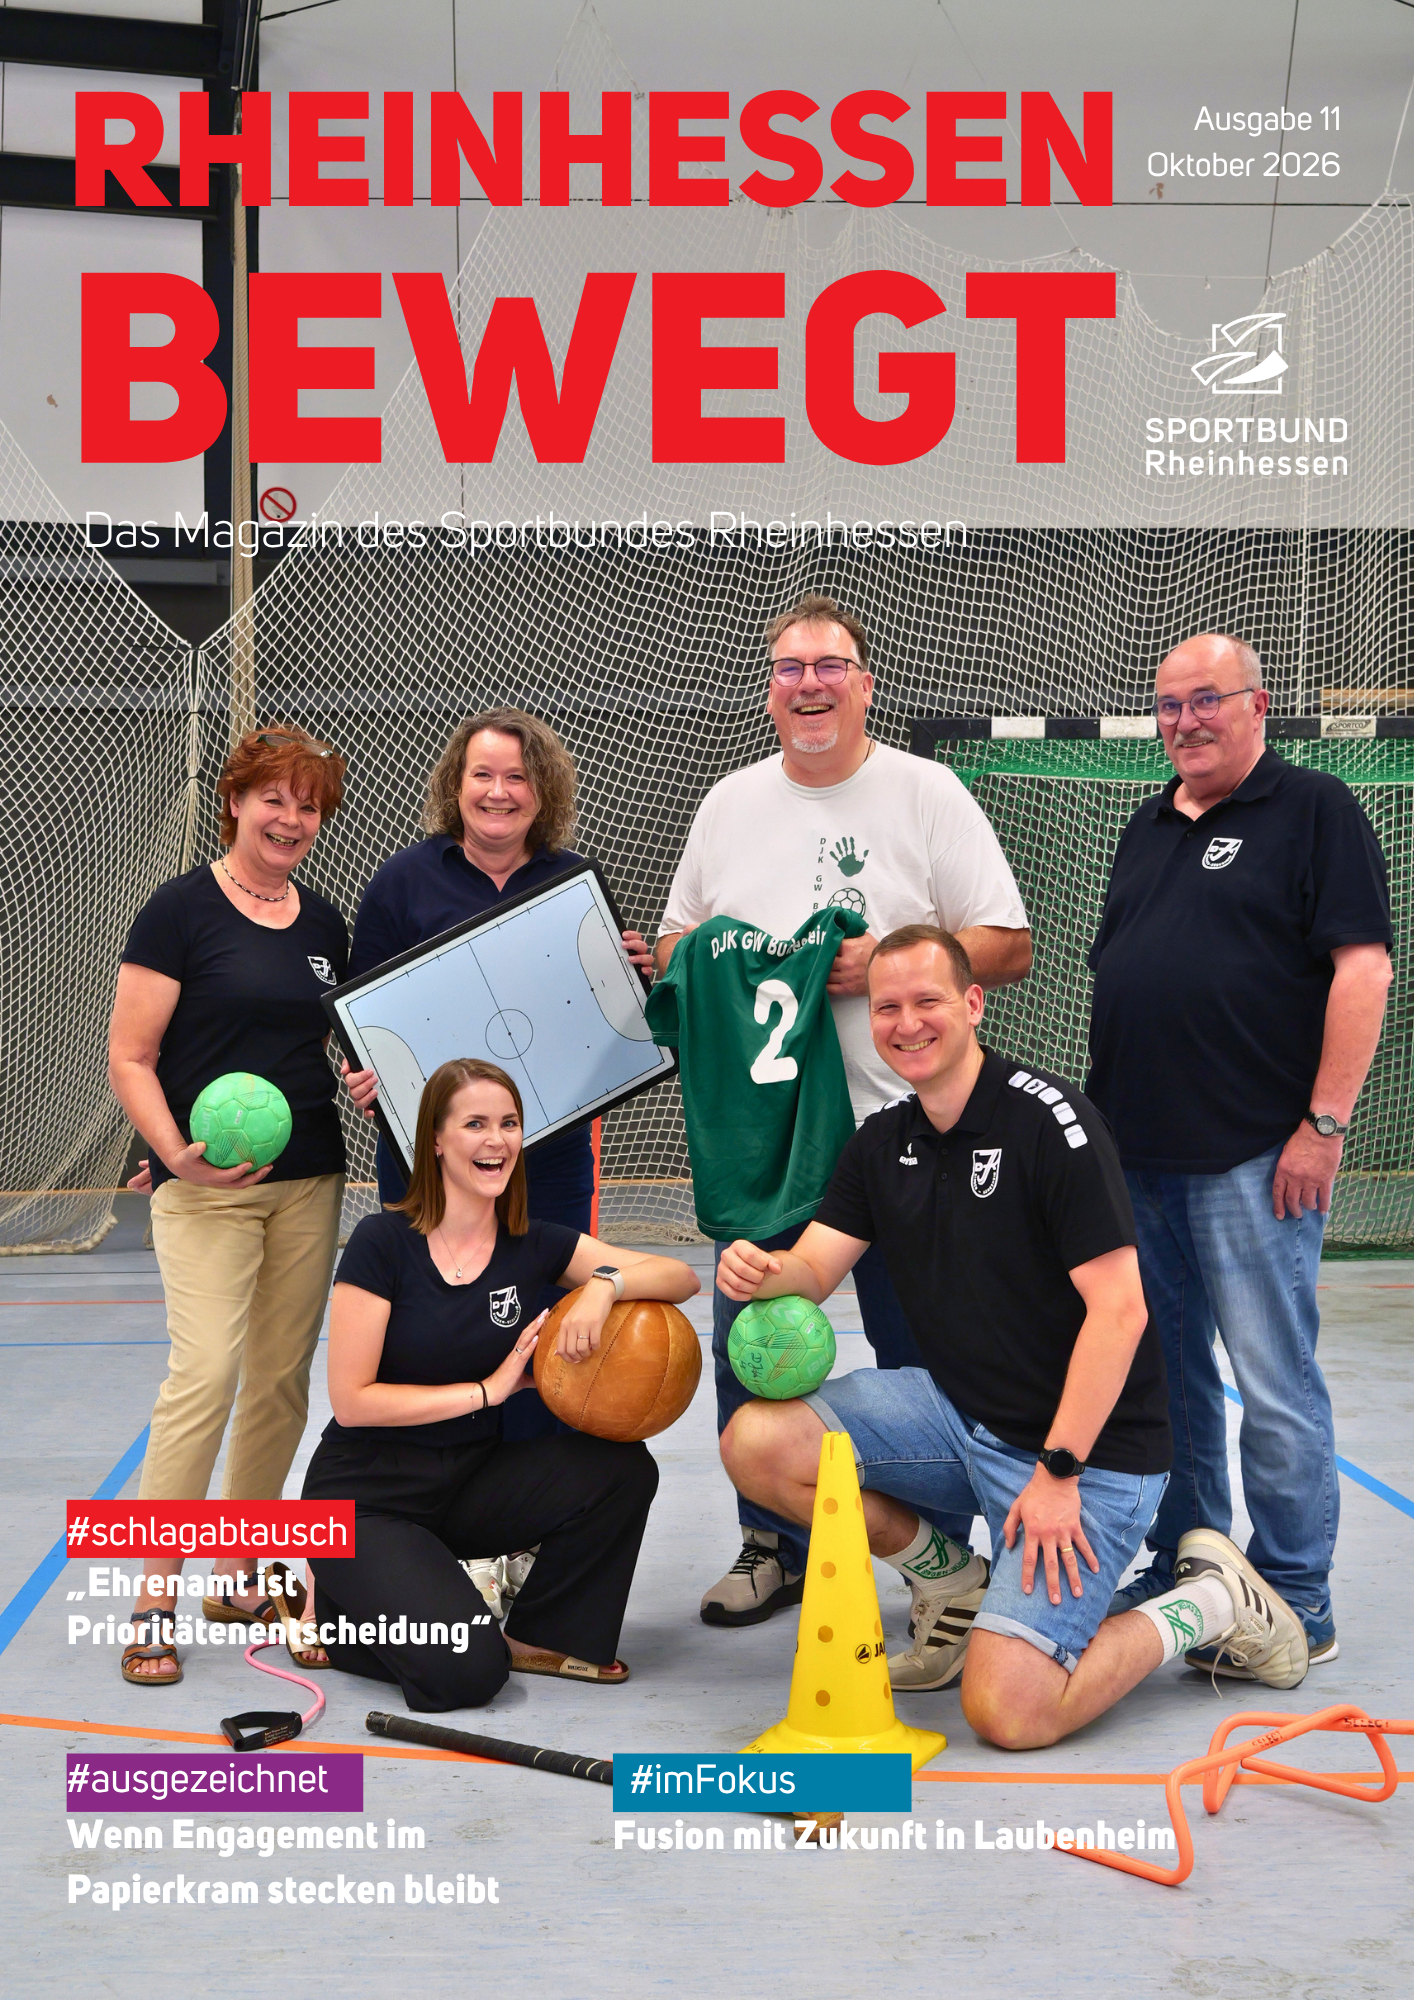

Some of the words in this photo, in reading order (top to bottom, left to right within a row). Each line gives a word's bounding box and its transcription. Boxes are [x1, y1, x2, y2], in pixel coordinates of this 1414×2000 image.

[710, 929, 738, 960] DJK
[741, 930, 767, 953] GW
[750, 979, 799, 1085] 2
